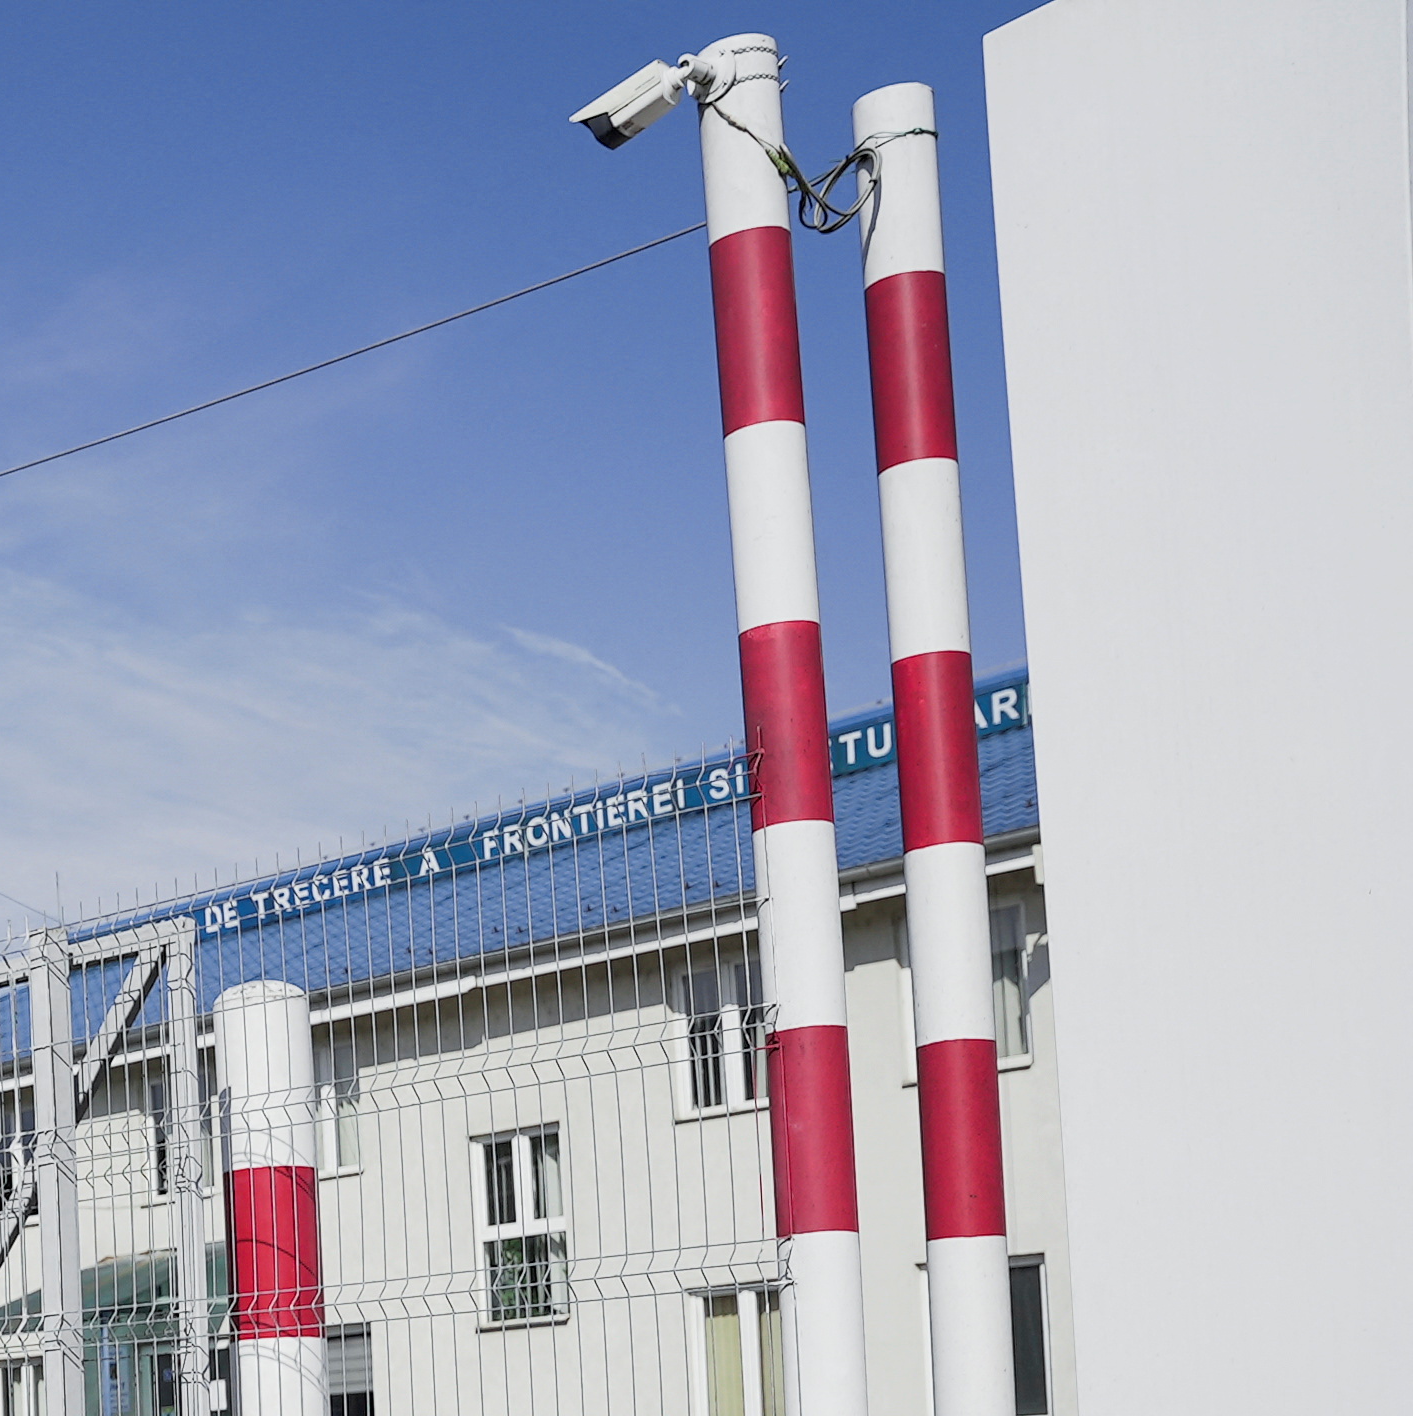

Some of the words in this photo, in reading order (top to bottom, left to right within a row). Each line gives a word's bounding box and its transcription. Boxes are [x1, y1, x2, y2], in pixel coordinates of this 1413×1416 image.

[205, 900, 240, 933] DE
[251, 858, 392, 919] TRECERE
[419, 847, 441, 876] A
[482, 778, 686, 860] FRONTIEREI
